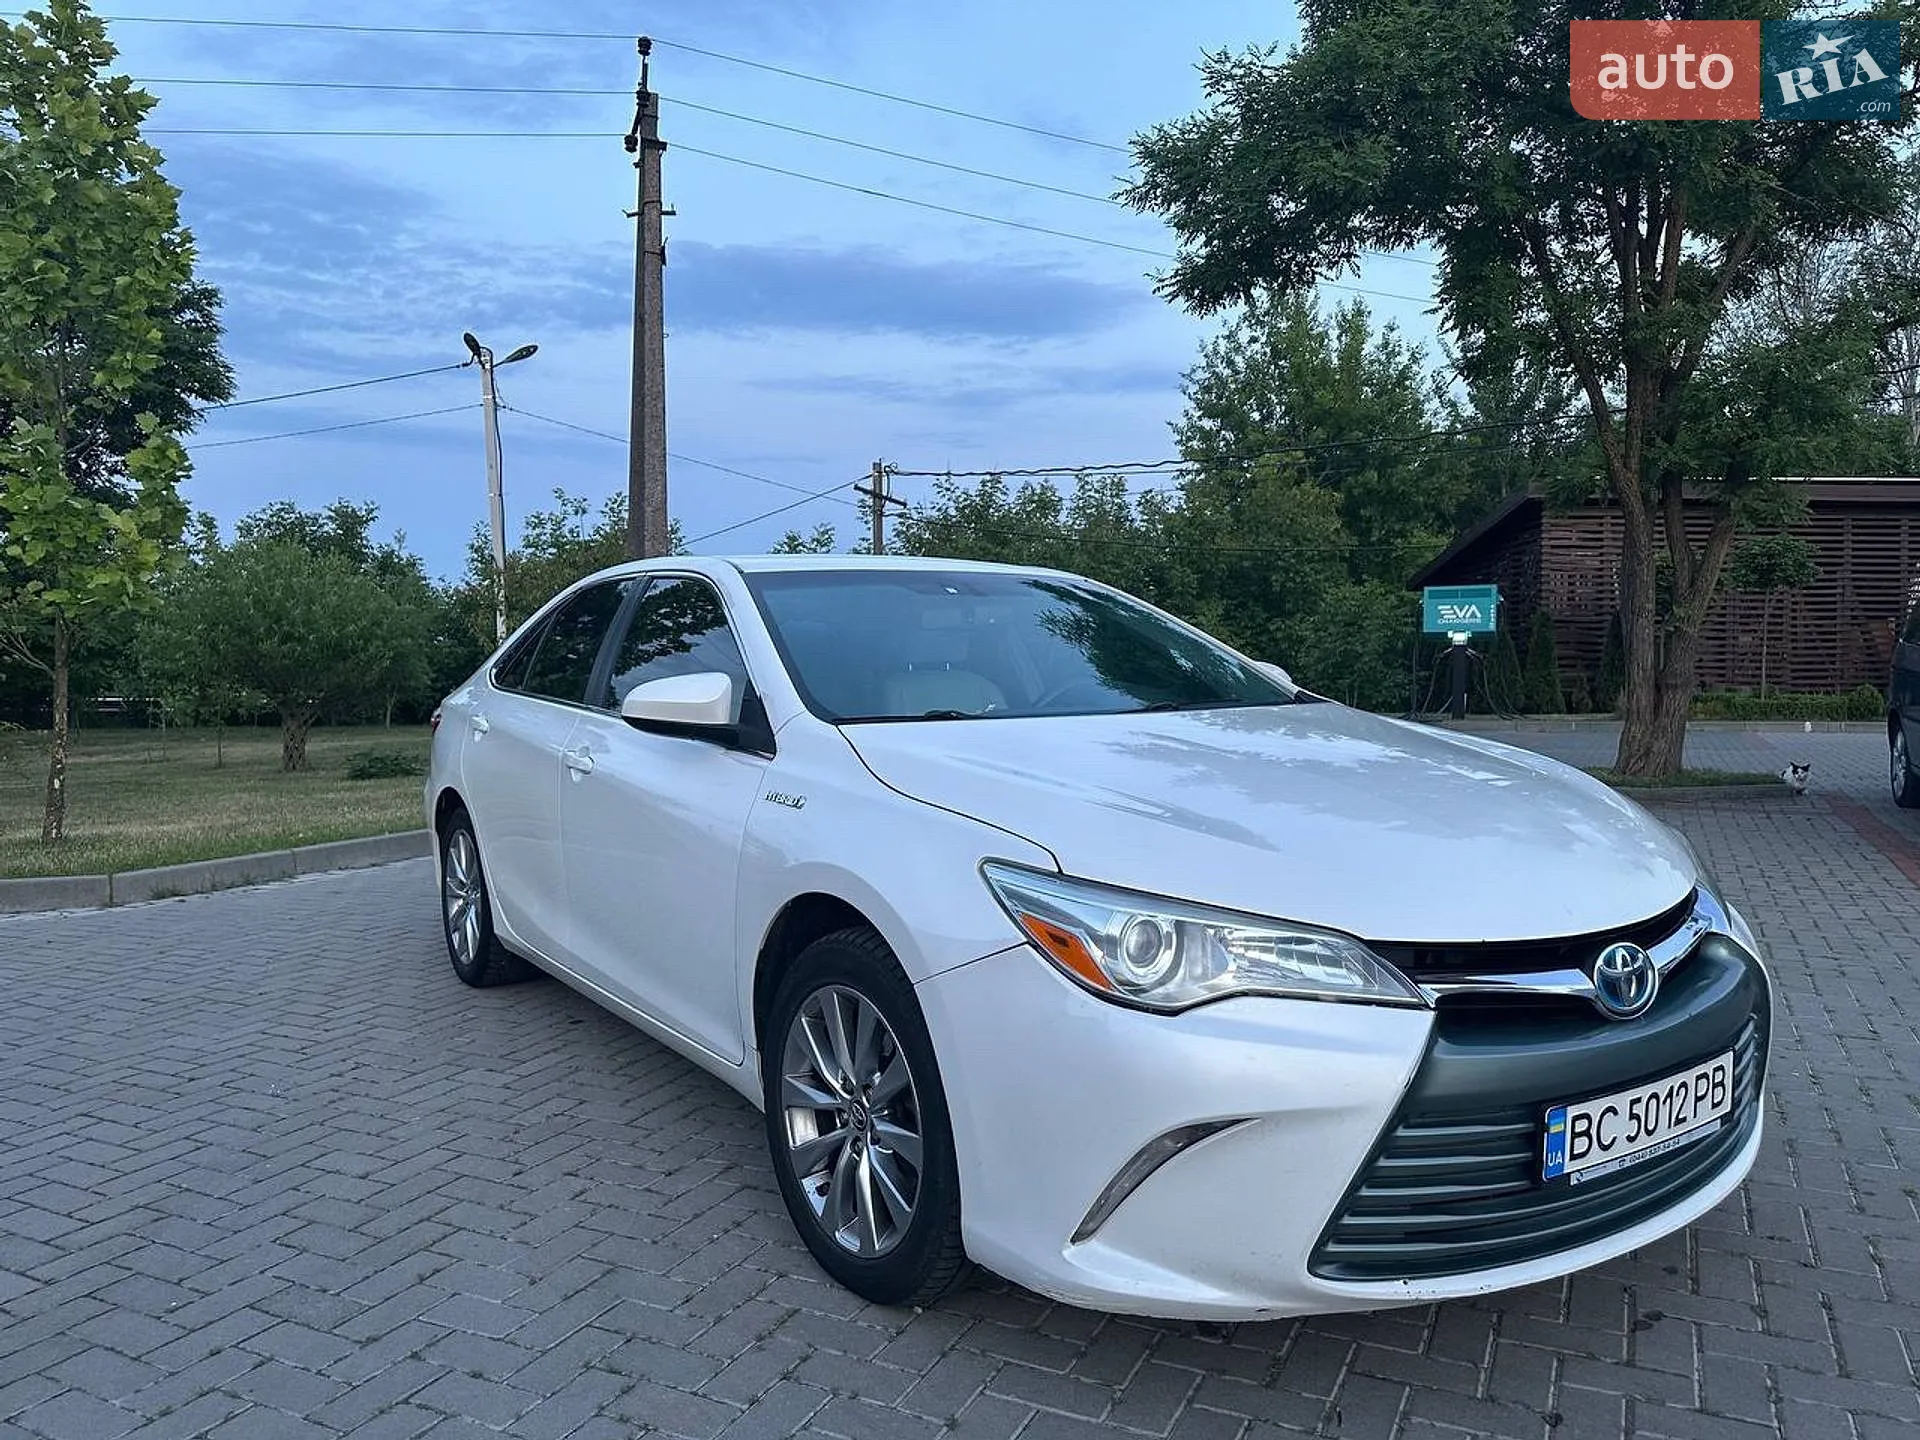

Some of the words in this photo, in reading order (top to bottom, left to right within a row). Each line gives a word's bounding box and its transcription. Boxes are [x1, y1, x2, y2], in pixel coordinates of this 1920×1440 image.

[1437, 604, 1482, 618] EVA
[1569, 1105, 1619, 1161] BC
[1626, 1081, 1689, 1143] 5012
[1693, 1063, 1726, 1119] PB
[1548, 1152, 1563, 1167] UA
